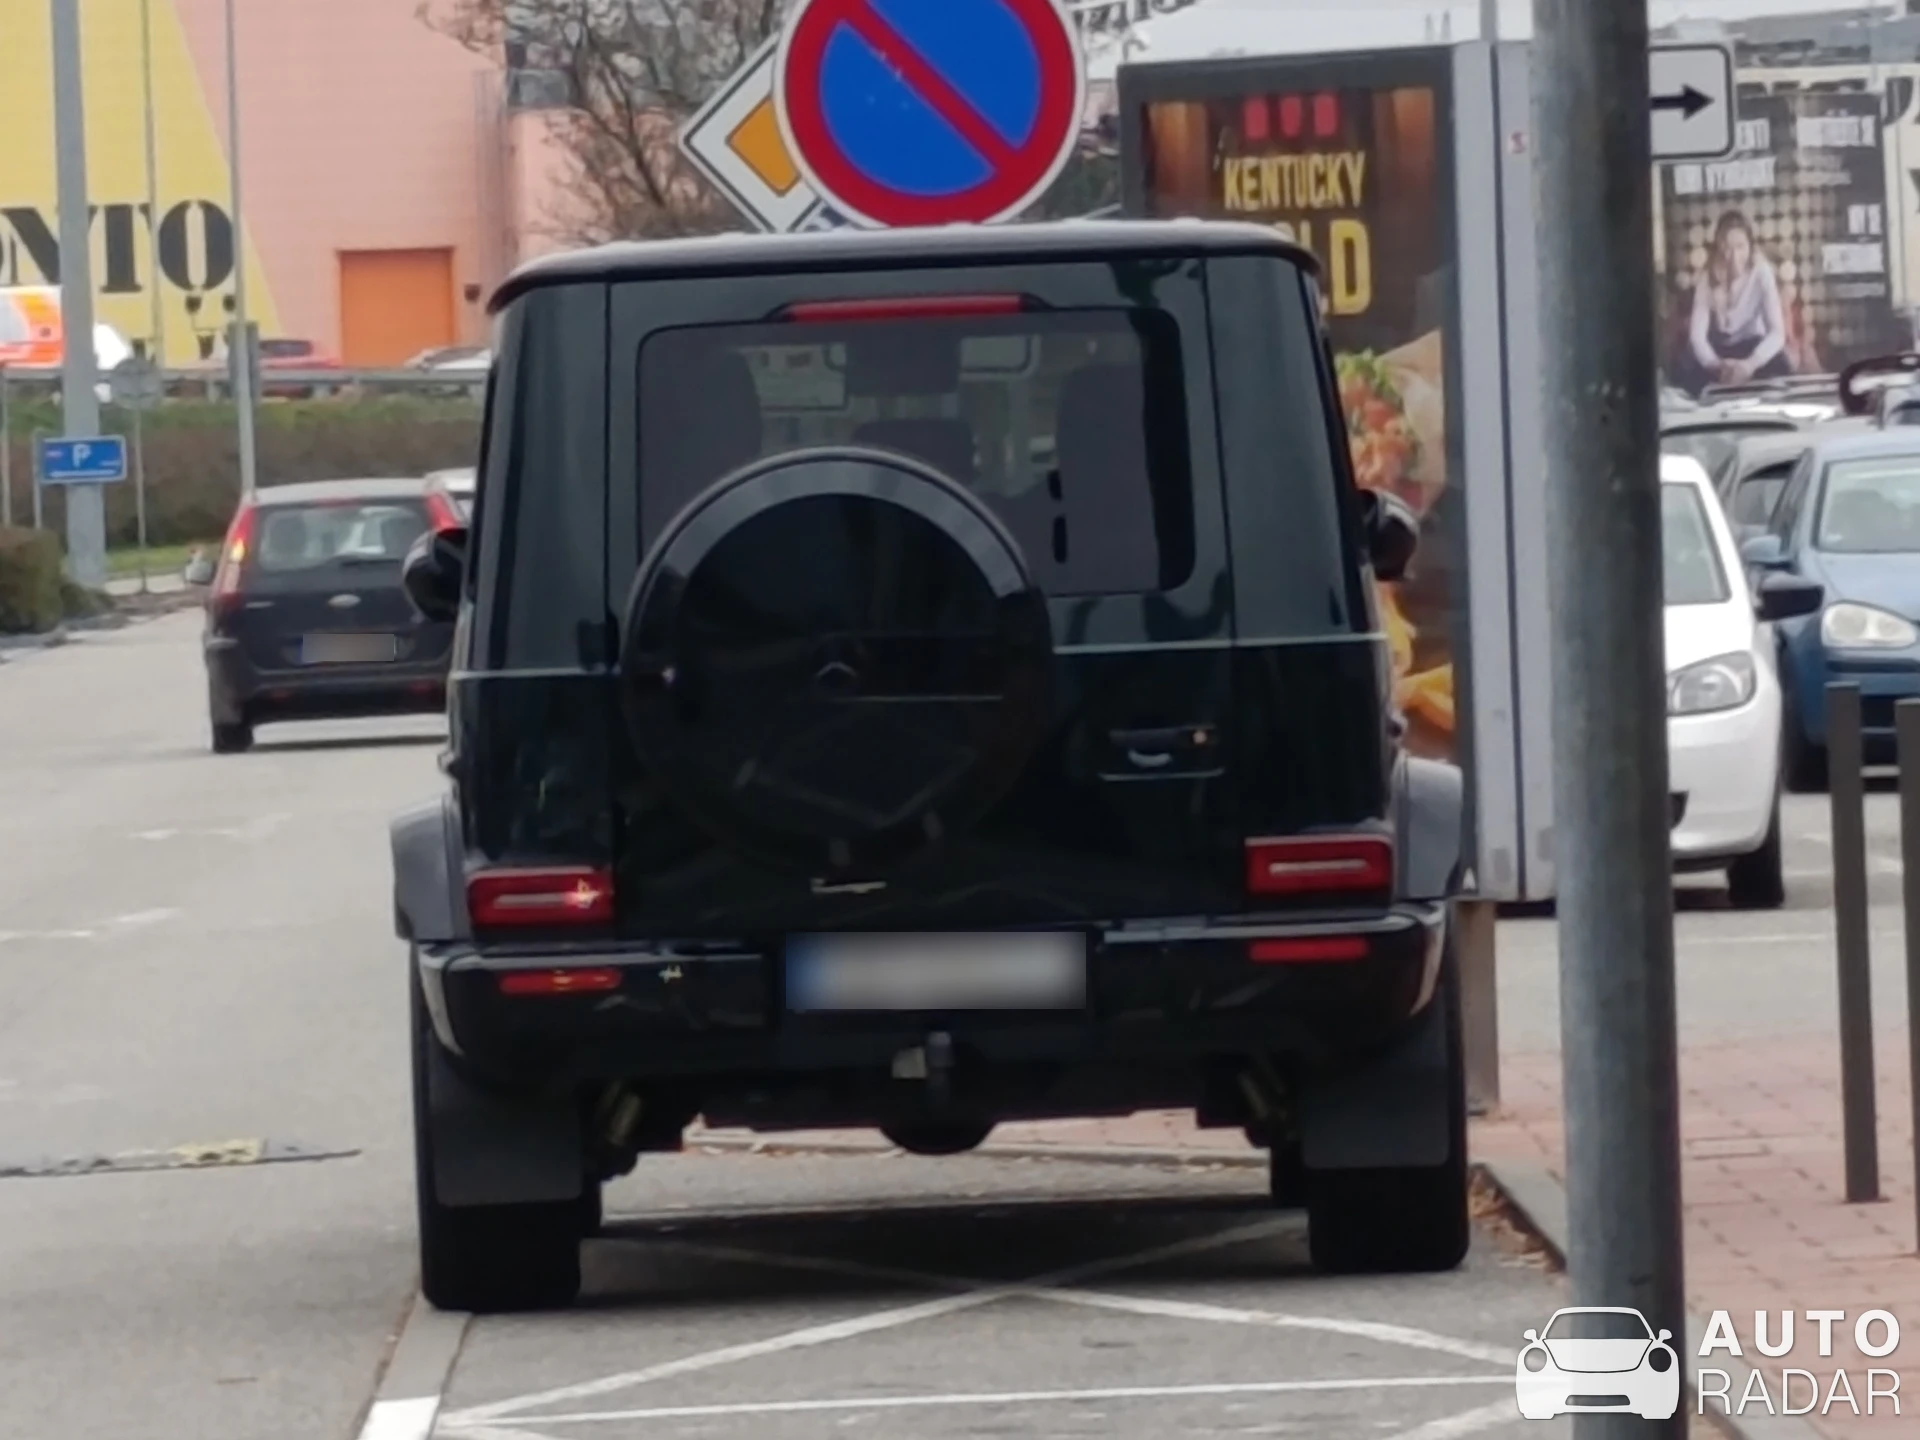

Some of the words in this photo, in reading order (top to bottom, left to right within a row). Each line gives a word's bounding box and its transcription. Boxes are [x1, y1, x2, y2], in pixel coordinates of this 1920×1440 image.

[1224, 150, 1365, 211] KENTUCKY
[0, 199, 236, 294] NTO
[72, 443, 92, 468] P
